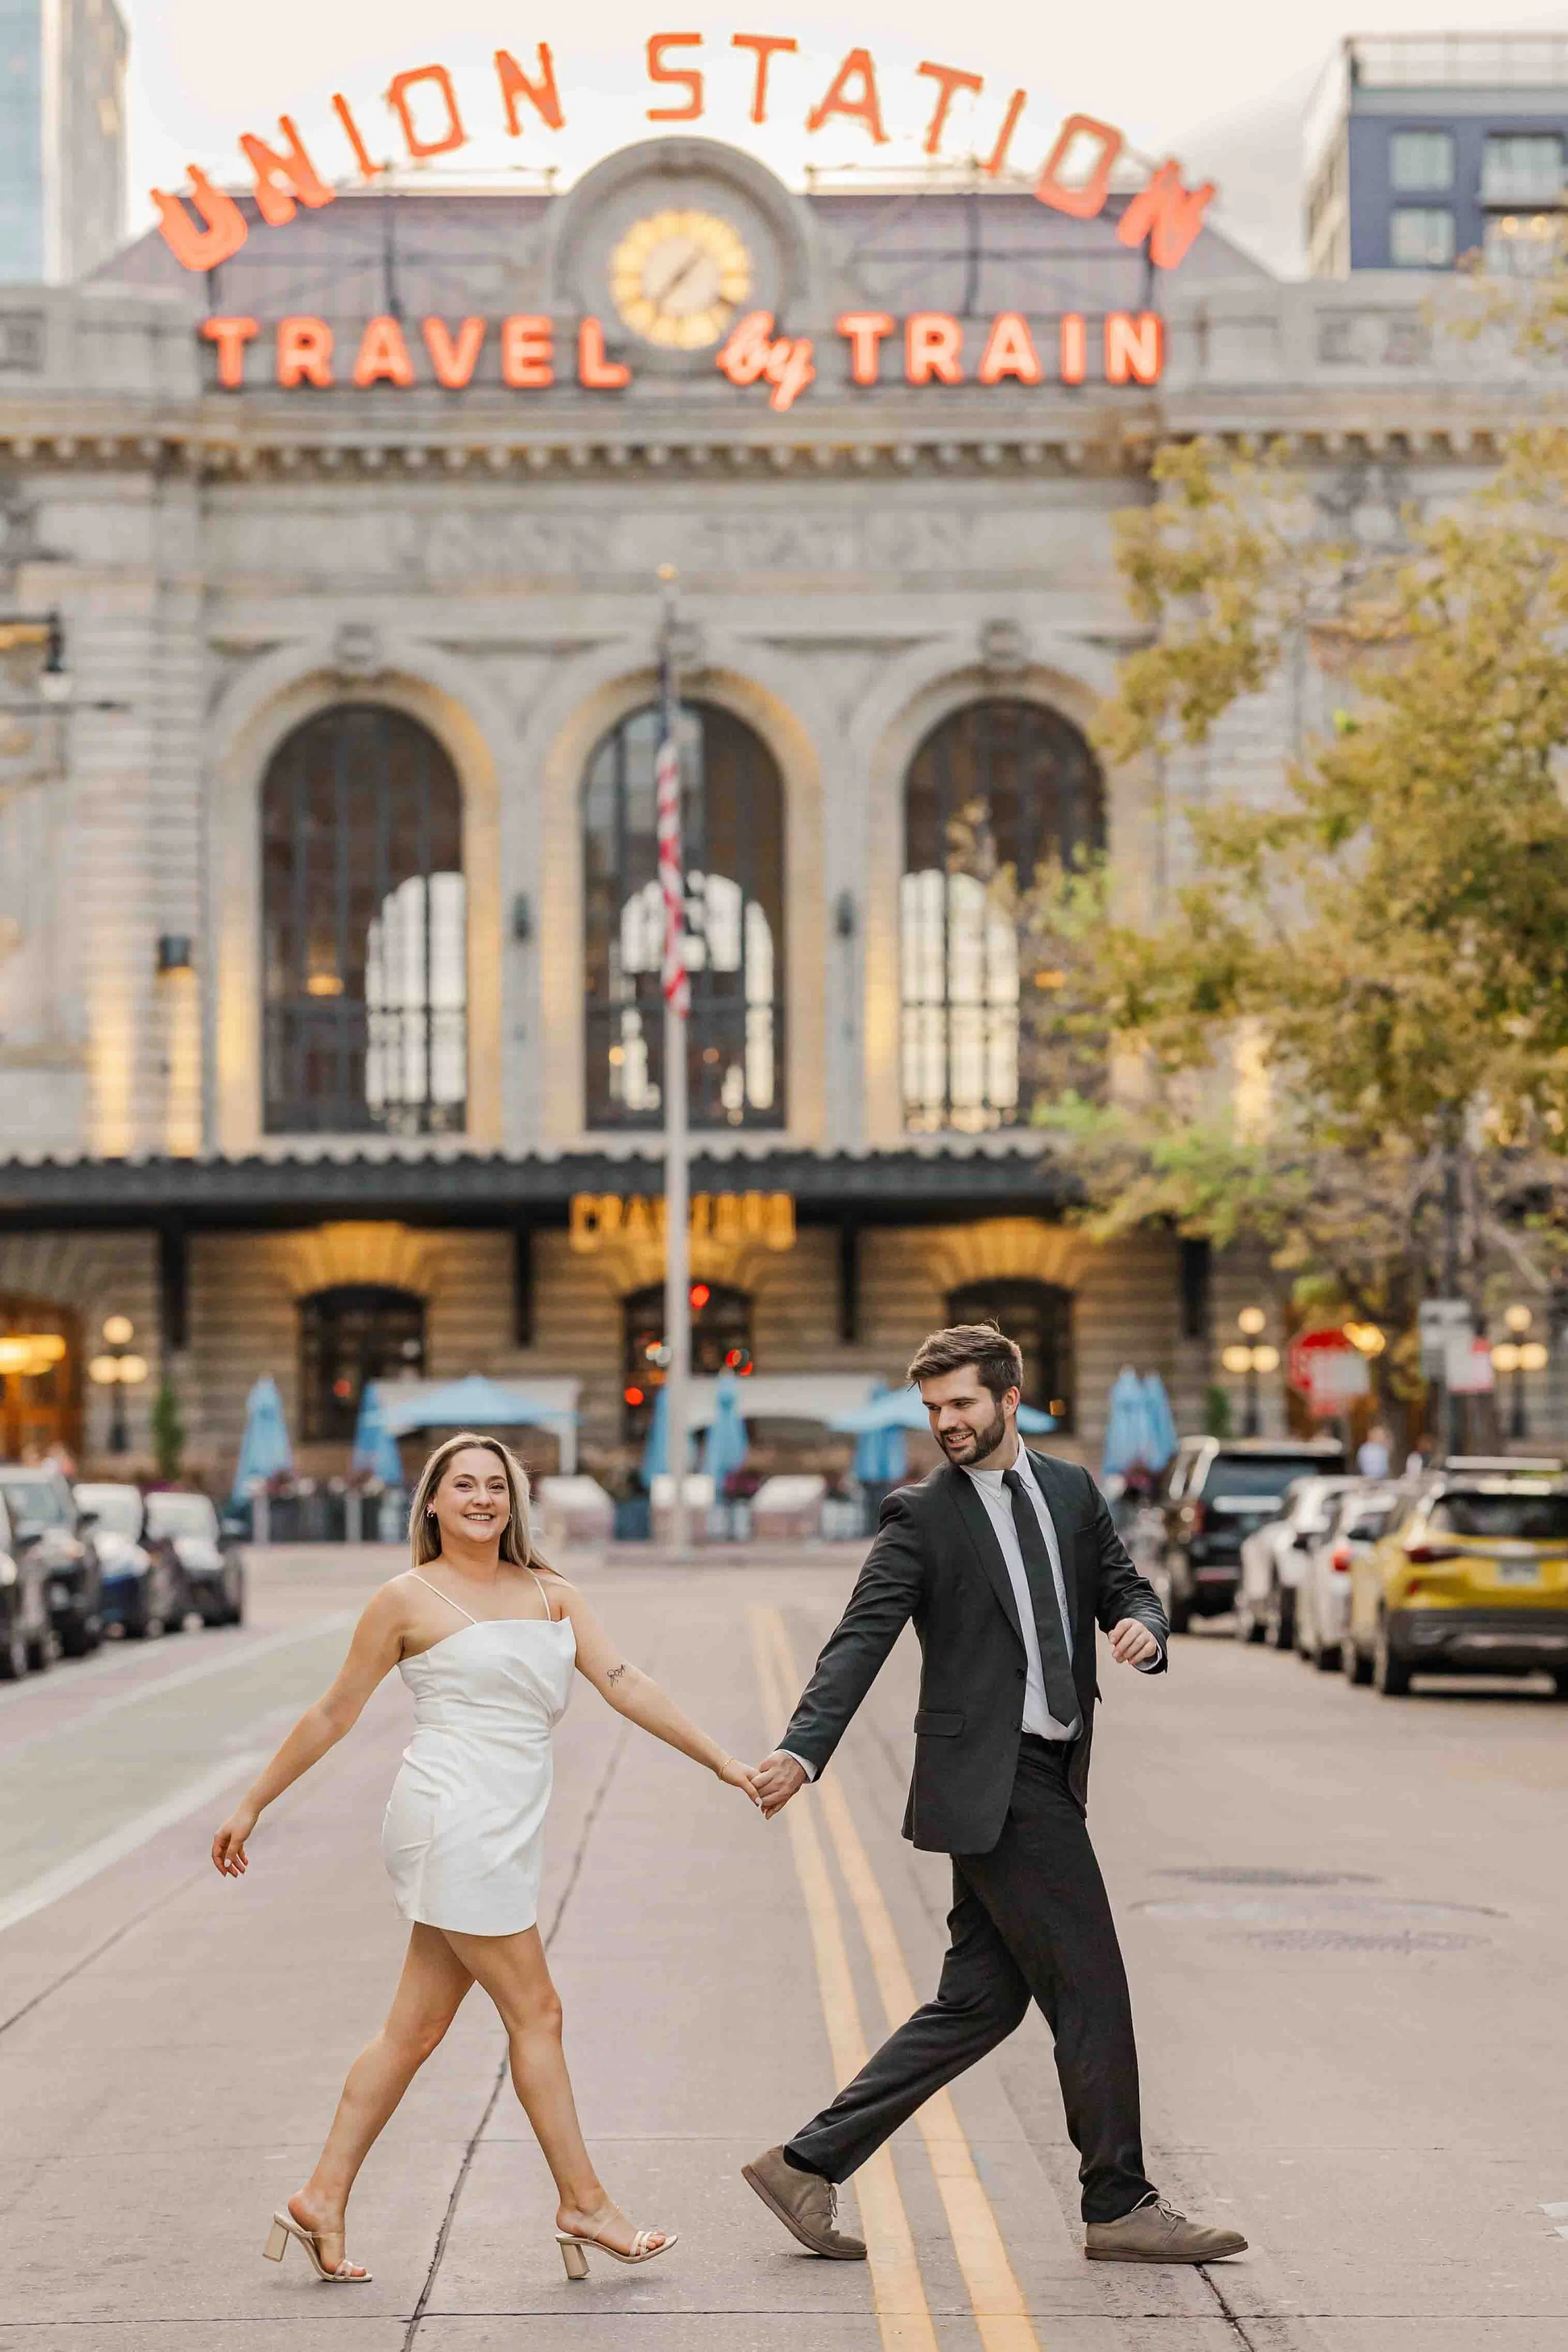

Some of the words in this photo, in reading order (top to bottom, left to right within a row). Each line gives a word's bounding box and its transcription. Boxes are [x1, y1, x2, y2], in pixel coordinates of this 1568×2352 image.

[149, 43, 566, 272] UNION
[645, 31, 1217, 271] STATION
[201, 314, 631, 388] TRAVEL
[714, 310, 817, 412] by
[834, 310, 1165, 385] TRAIN
